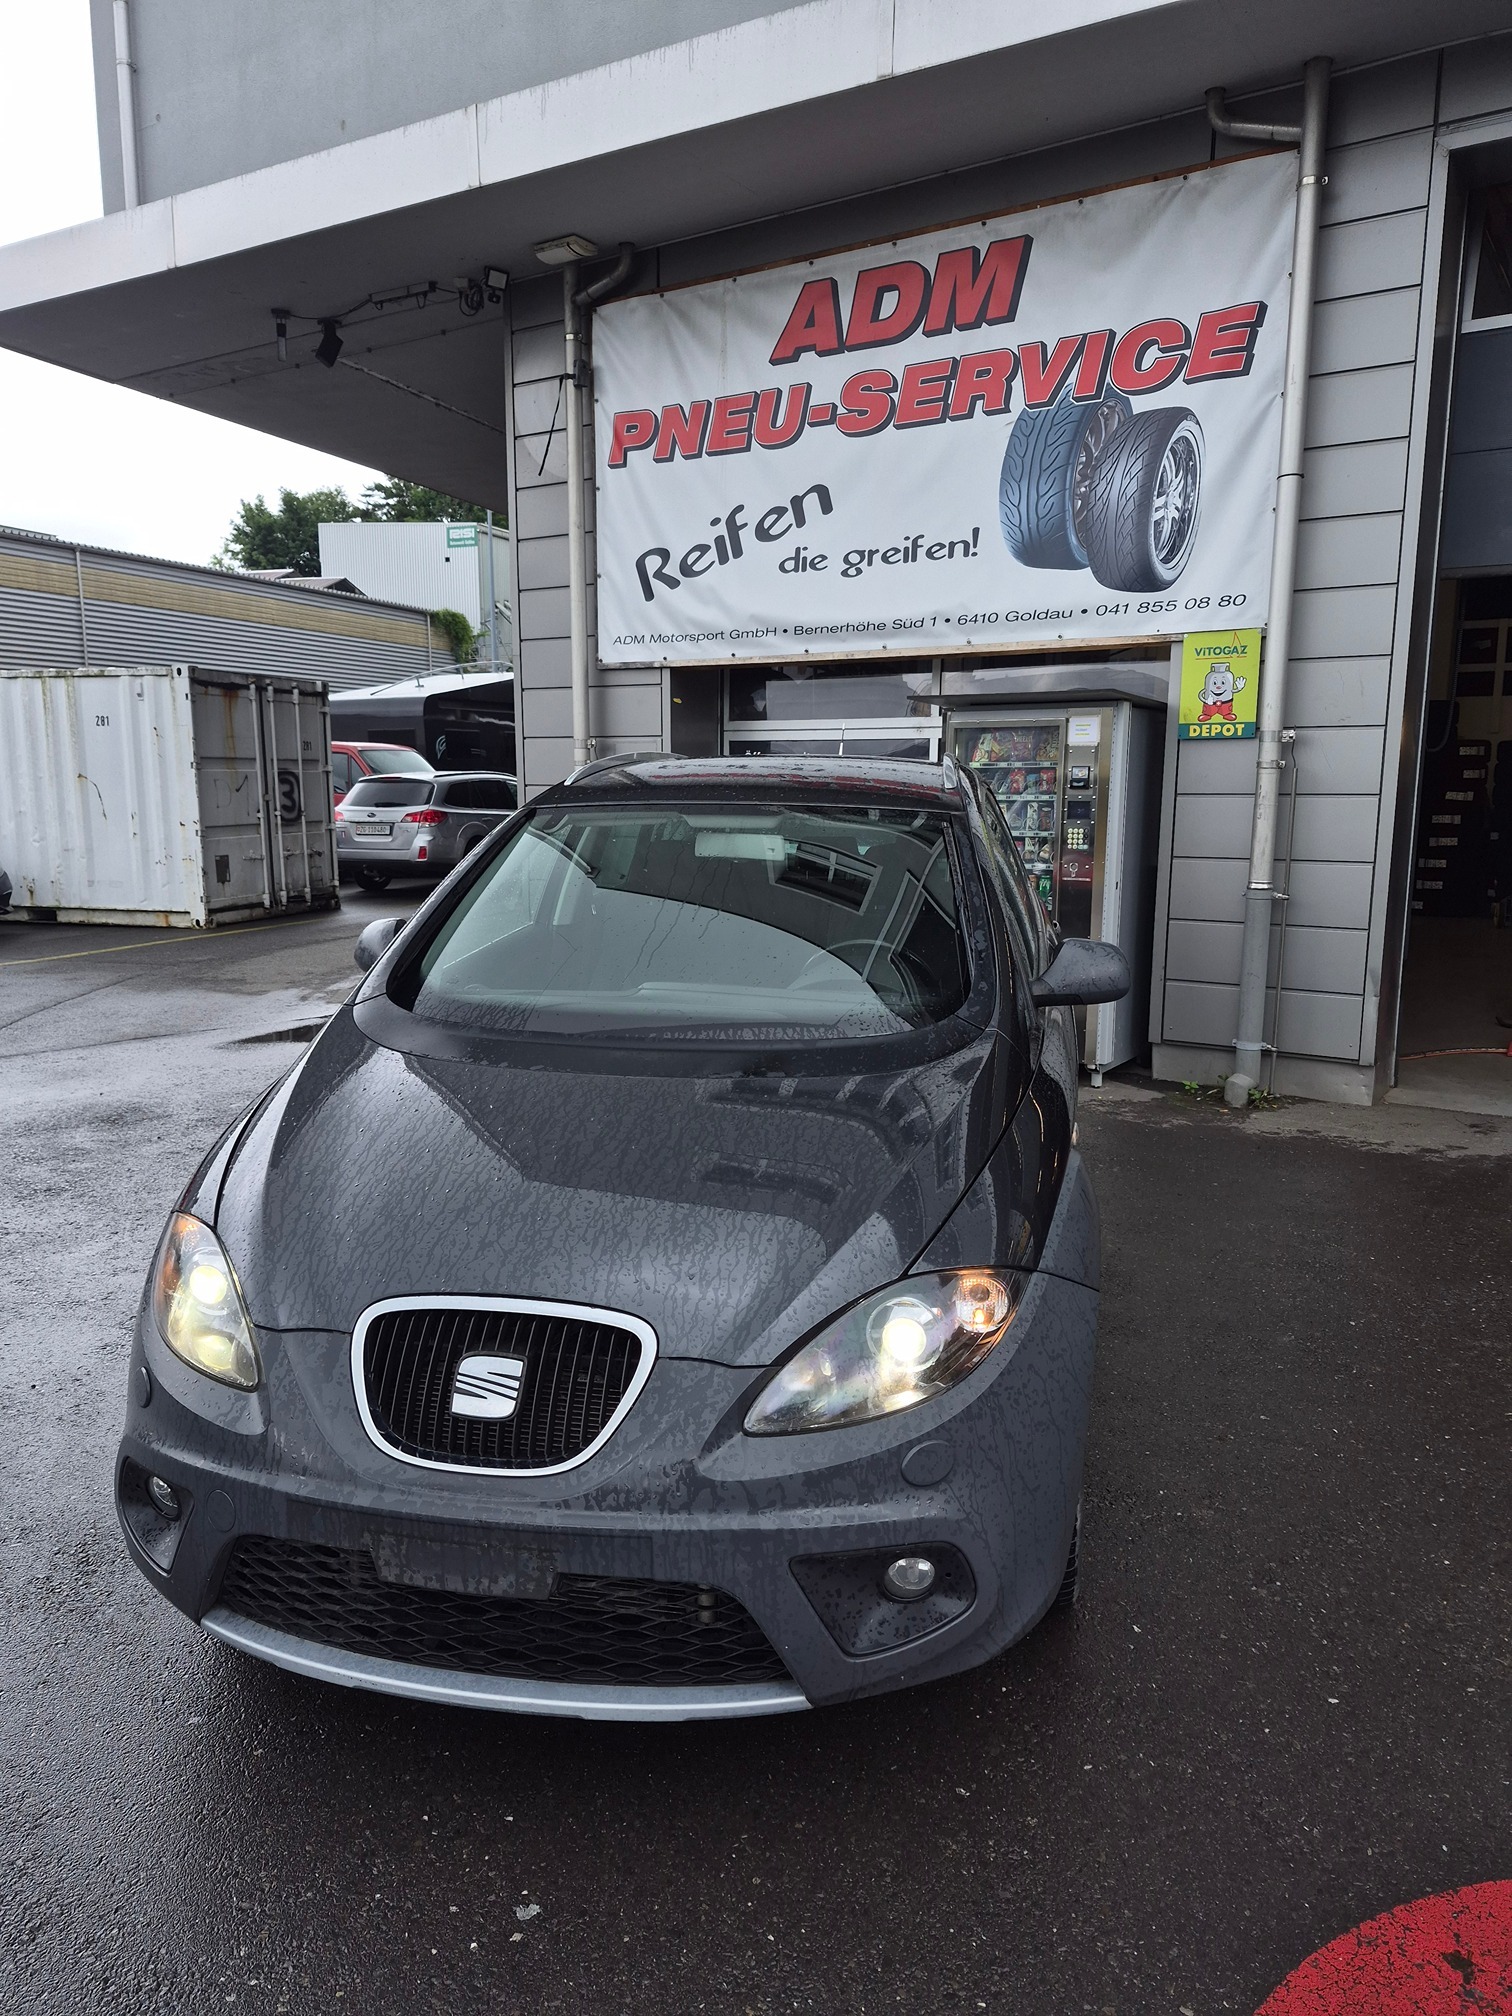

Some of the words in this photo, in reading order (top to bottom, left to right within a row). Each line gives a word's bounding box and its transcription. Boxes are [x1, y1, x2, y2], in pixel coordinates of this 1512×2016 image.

[769, 234, 1033, 366] ADM
[607, 300, 1267, 469] PNEU-SERVICE
[635, 484, 834, 602] Reifen
[778, 546, 828, 574] die
[840, 527, 980, 578] greifen!
[613, 635, 645, 646] ADM
[650, 630, 725, 643] Motorsport
[729, 627, 777, 640] GmbH
[794, 621, 887, 636] Bernerhöhe
[892, 617, 925, 630] Süd
[930, 616, 937, 627] 1
[957, 612, 999, 626] 6410
[1005, 608, 1073, 623] Goldau
[1095, 603, 1129, 617] 041
[1137, 600, 1178, 614] 855
[1184, 596, 1211, 610] 08
[1217, 593, 1247, 608] 80
[95, 715, 110, 727] 281
[1189, 723, 1245, 737] DEPOT
